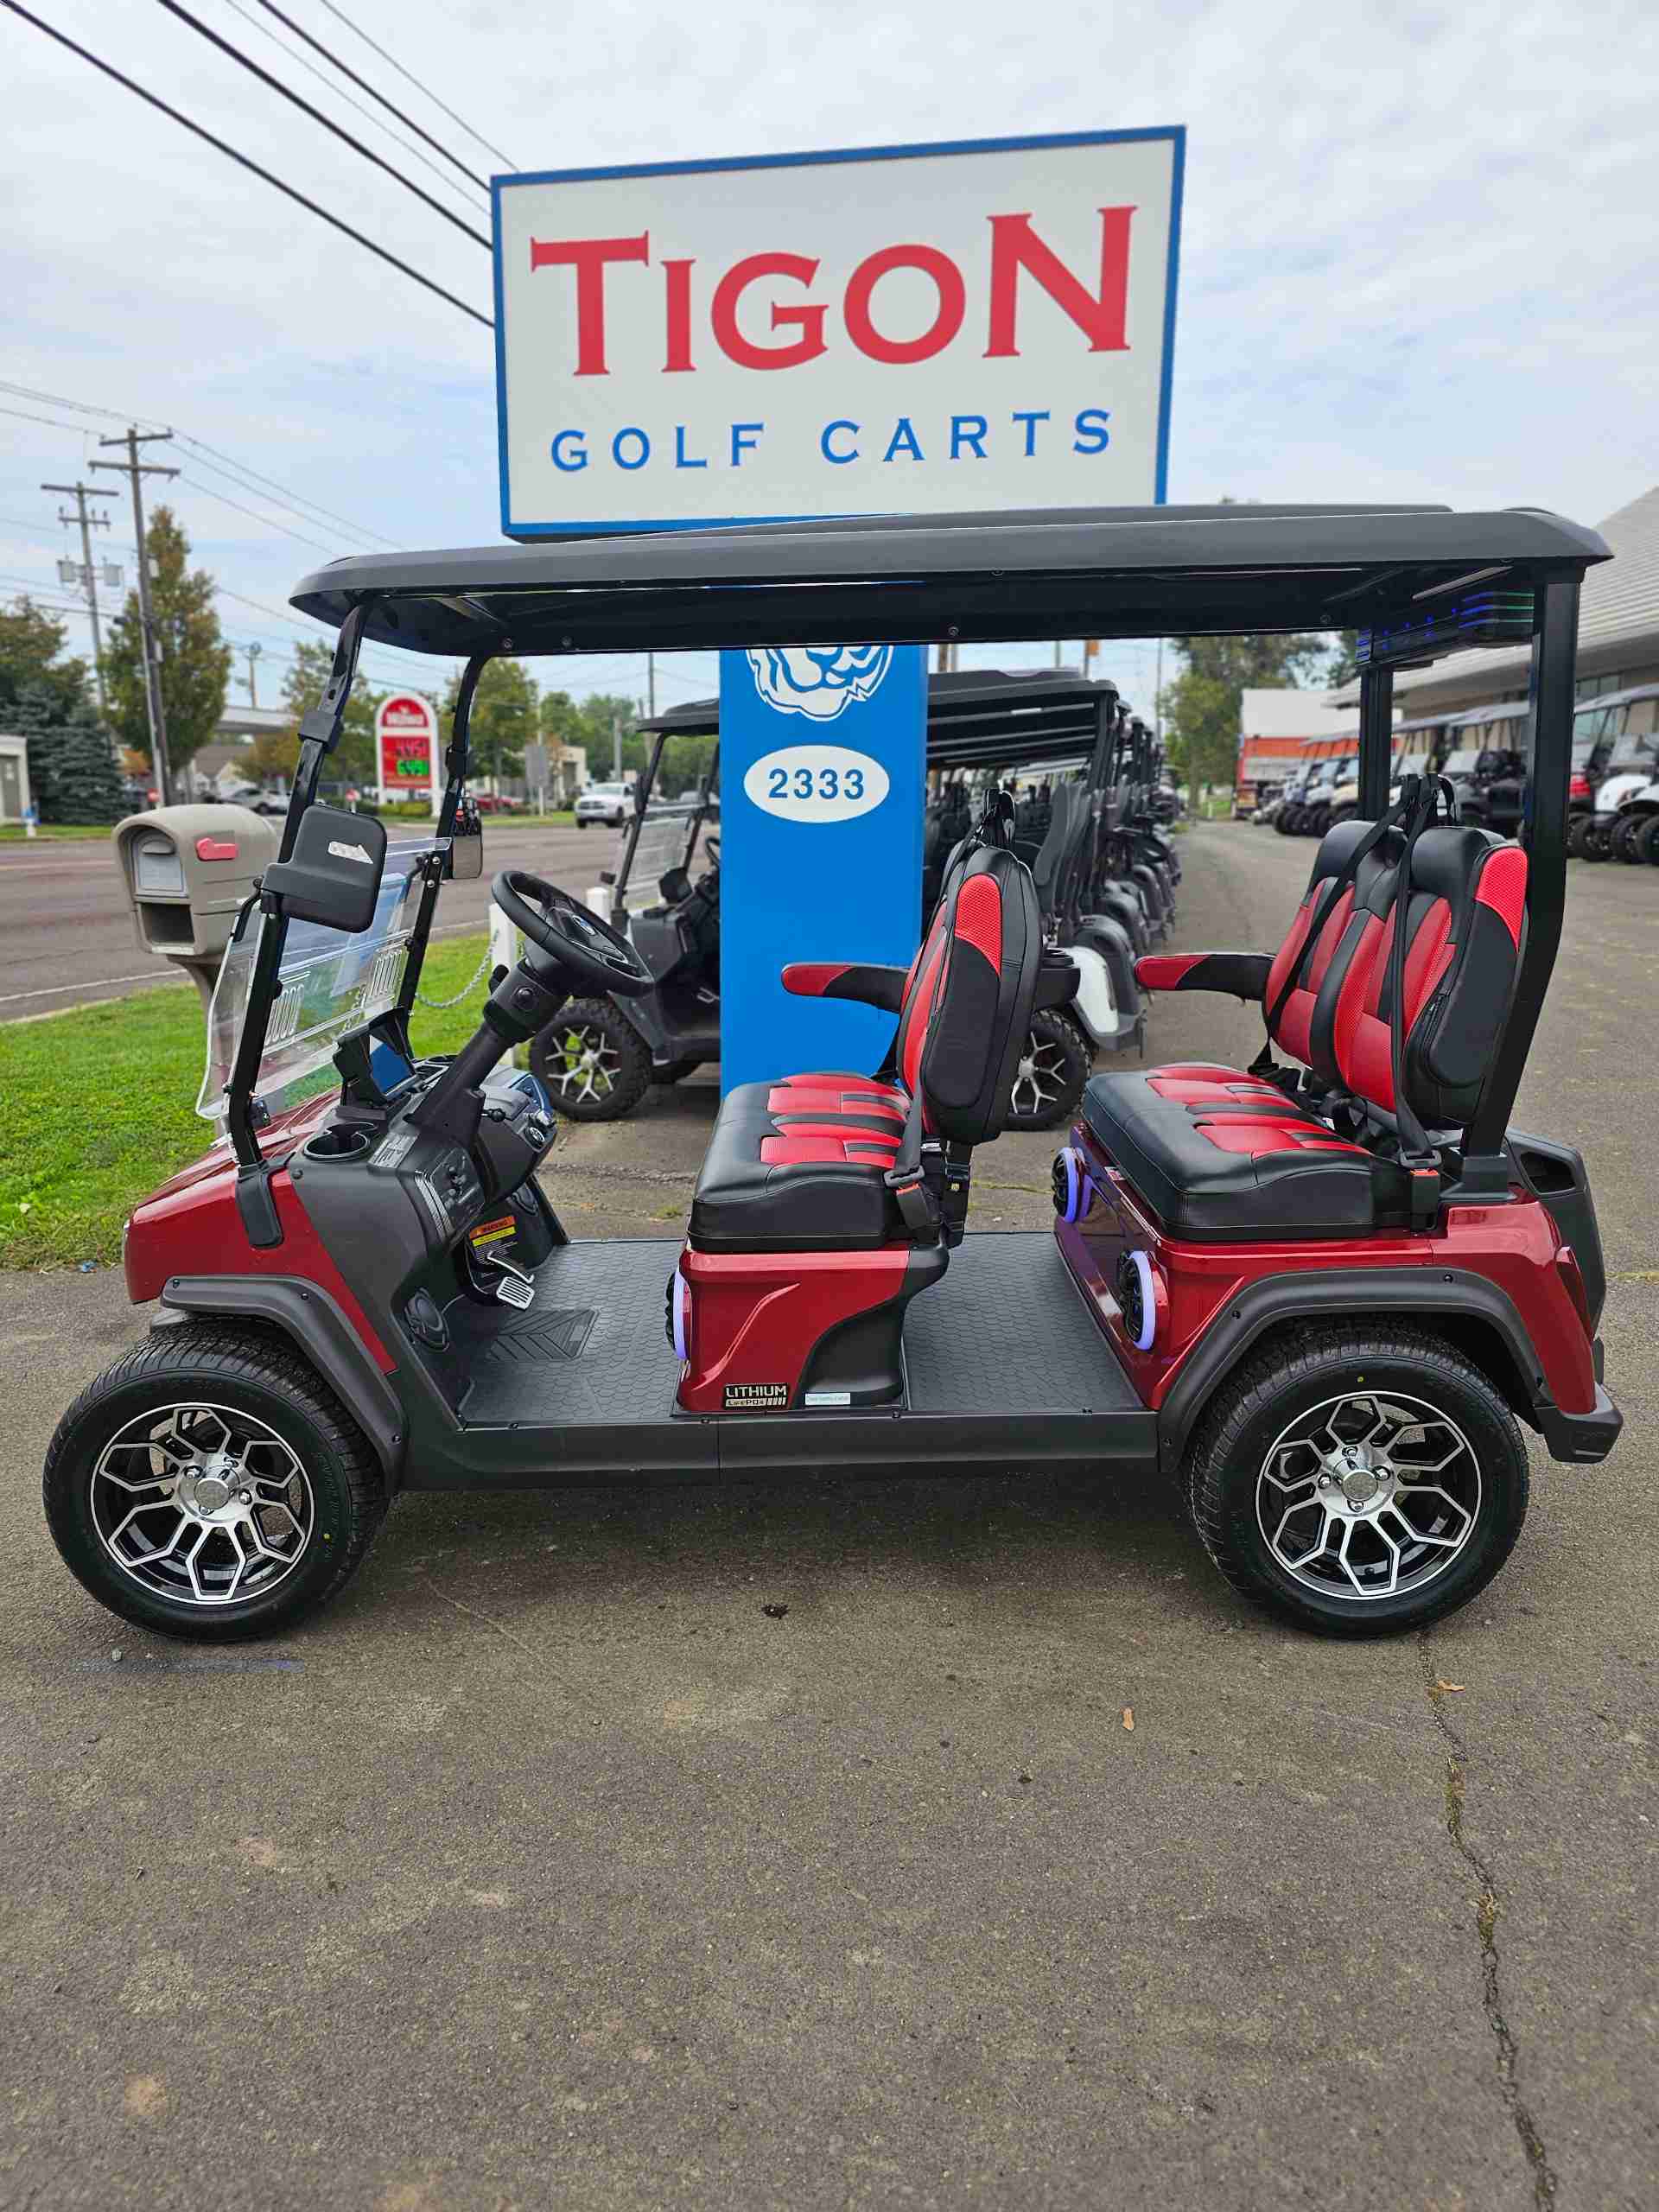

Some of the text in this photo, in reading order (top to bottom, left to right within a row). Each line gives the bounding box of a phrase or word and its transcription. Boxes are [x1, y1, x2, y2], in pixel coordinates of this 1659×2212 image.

[530, 204, 1138, 377] TIGON
[550, 409, 1112, 472] GOLF CARTS
[767, 767, 865, 800] 2333
[726, 1385, 787, 1397] LITHIUM
